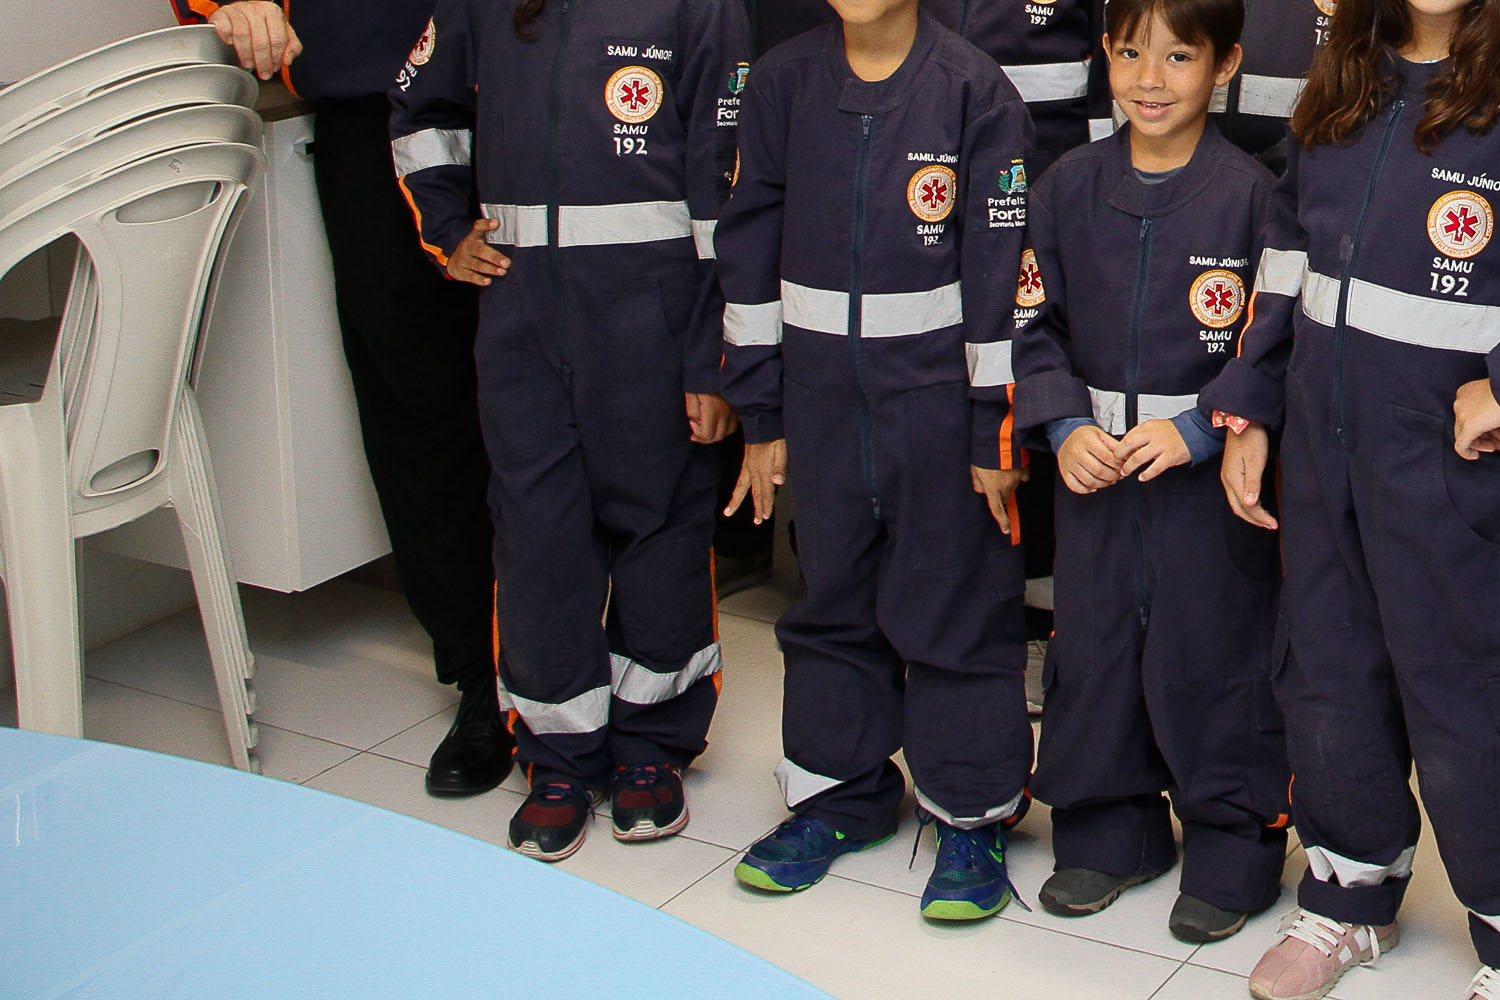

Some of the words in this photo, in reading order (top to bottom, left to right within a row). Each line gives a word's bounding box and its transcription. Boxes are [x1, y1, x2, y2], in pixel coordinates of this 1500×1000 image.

[1025, 4, 1054, 16] SAMU
[1030, 15, 1047, 26] 192
[1316, 16, 1329, 26] SA
[607, 45, 637, 57] SAMU
[642, 44, 673, 60] JÚNIOR
[396, 69, 411, 92] 92
[717, 97, 740, 106] Prefe
[613, 123, 648, 135] SAMU
[613, 136, 648, 156] 192
[907, 152, 936, 162] SAMU
[1431, 167, 1465, 184] SAMU
[987, 196, 1026, 207] Prefeit
[916, 224, 945, 235] SAMU
[1189, 255, 1216, 267] SAMU
[1433, 256, 1474, 273] SAMU
[1430, 272, 1469, 297] 192
[1013, 308, 1038, 319] SAMU
[1199, 330, 1232, 341] SAMU
[1207, 342, 1225, 353] 192
